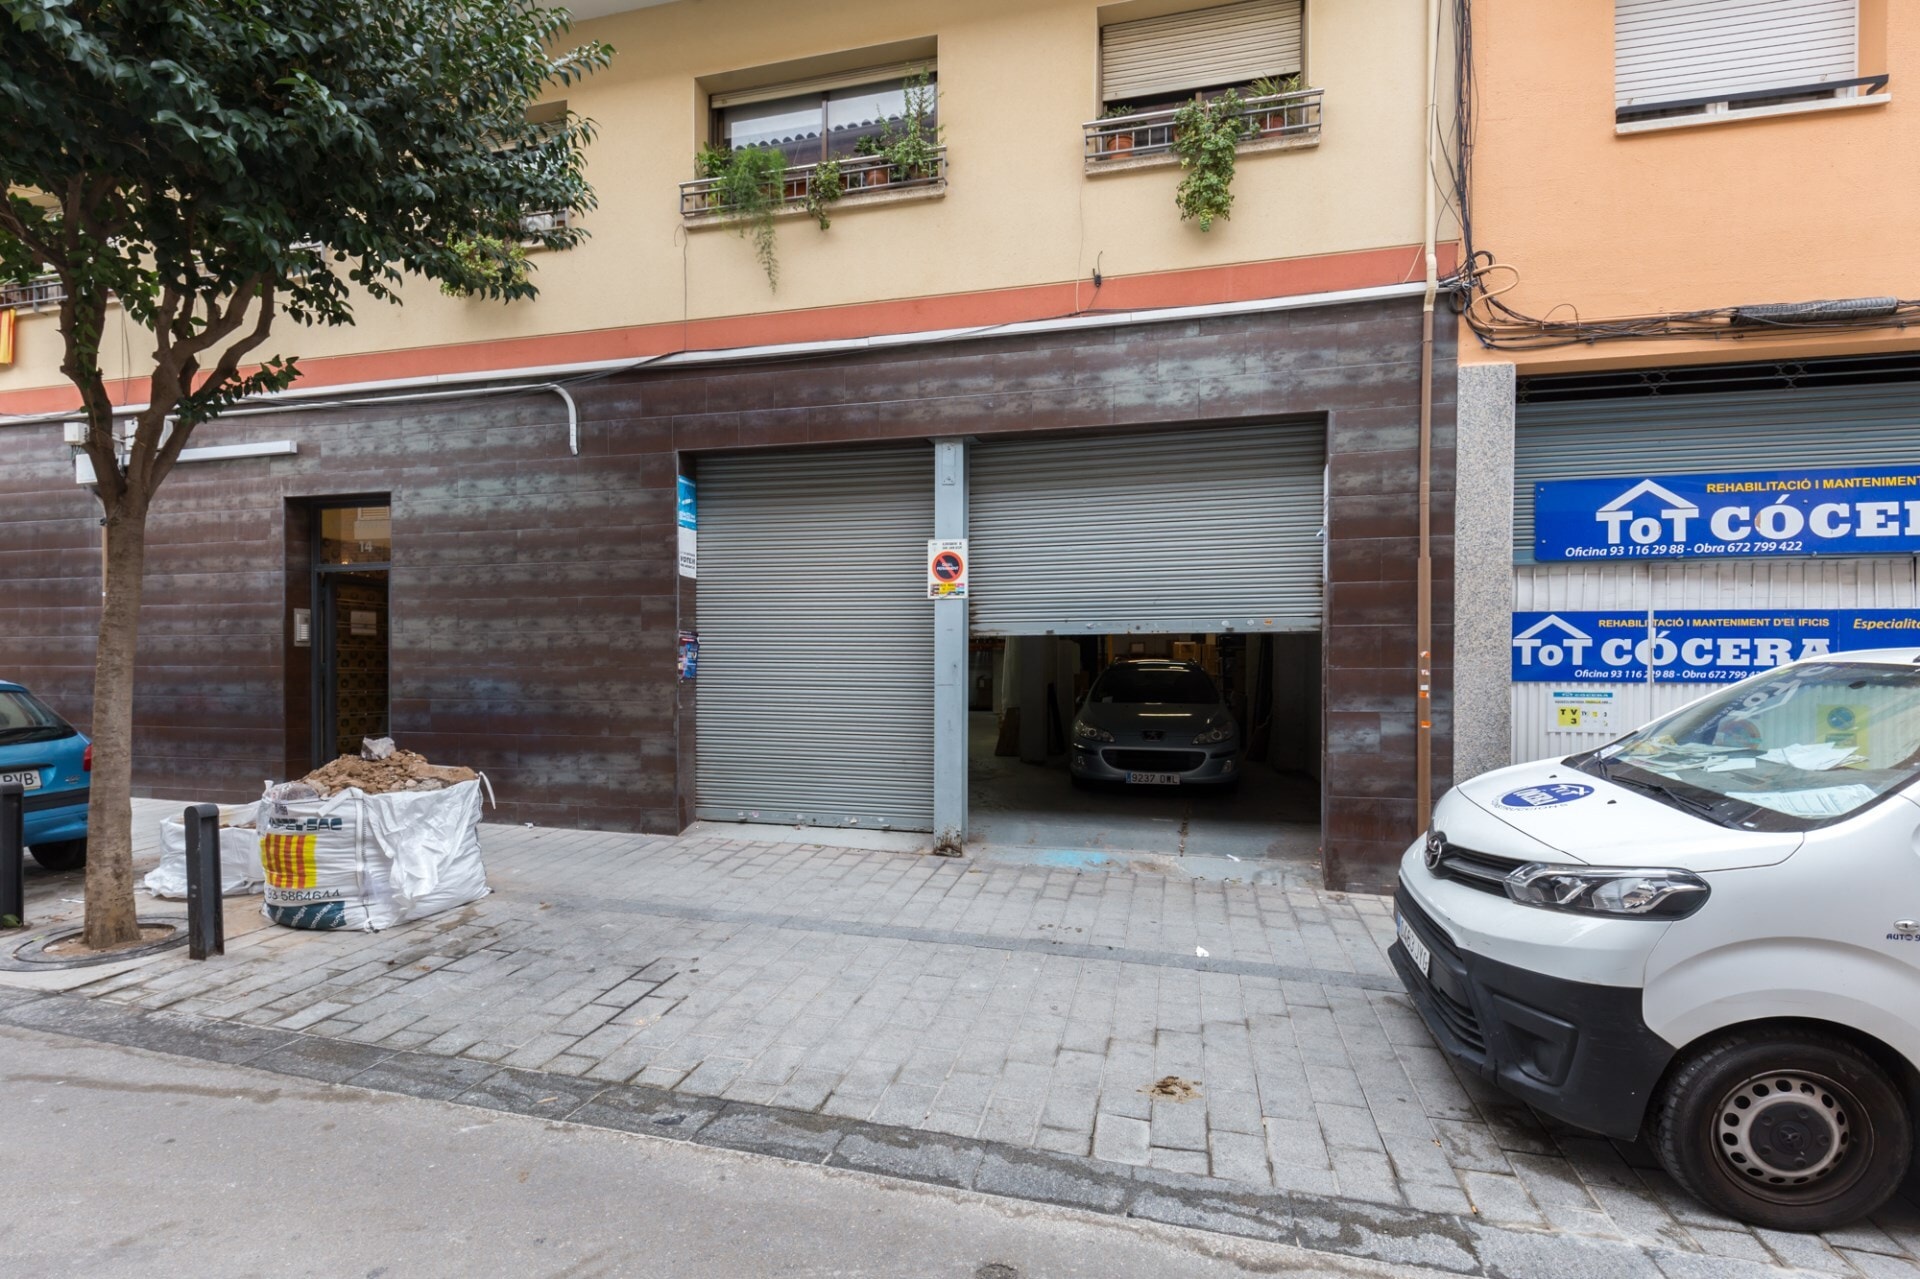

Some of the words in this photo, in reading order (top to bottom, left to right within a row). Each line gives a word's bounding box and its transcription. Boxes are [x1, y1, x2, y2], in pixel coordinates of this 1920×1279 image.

[1706, 479, 1811, 493] REHABILITACIÓ
[1815, 480, 1819, 489] I
[359, 541, 373, 552] 14
[1565, 546, 1607, 557] Oficina
[1610, 546, 1624, 556] 93
[1628, 545, 1649, 555] 116
[1650, 545, 1667, 555] 29
[1668, 544, 1684, 554] 88
[1694, 542, 1724, 553] Obra
[1727, 542, 1750, 552] 672
[1754, 542, 1776, 552] 799
[1779, 541, 1802, 551] 422
[1693, 618, 1770, 627] MANTENIMENT
[1600, 630, 1830, 666] CÓCERA
[1574, 669, 1608, 678] Oficina
[1610, 670, 1622, 678] 93
[1625, 669, 1642, 678] 116
[1663, 670, 1675, 678] 88
[1682, 670, 1706, 679] Obra
[1708, 670, 1726, 679] 672
[1729, 670, 1747, 679] 799
[1132, 773, 1155, 783] 9237
[1886, 933, 1913, 941] AUTO
